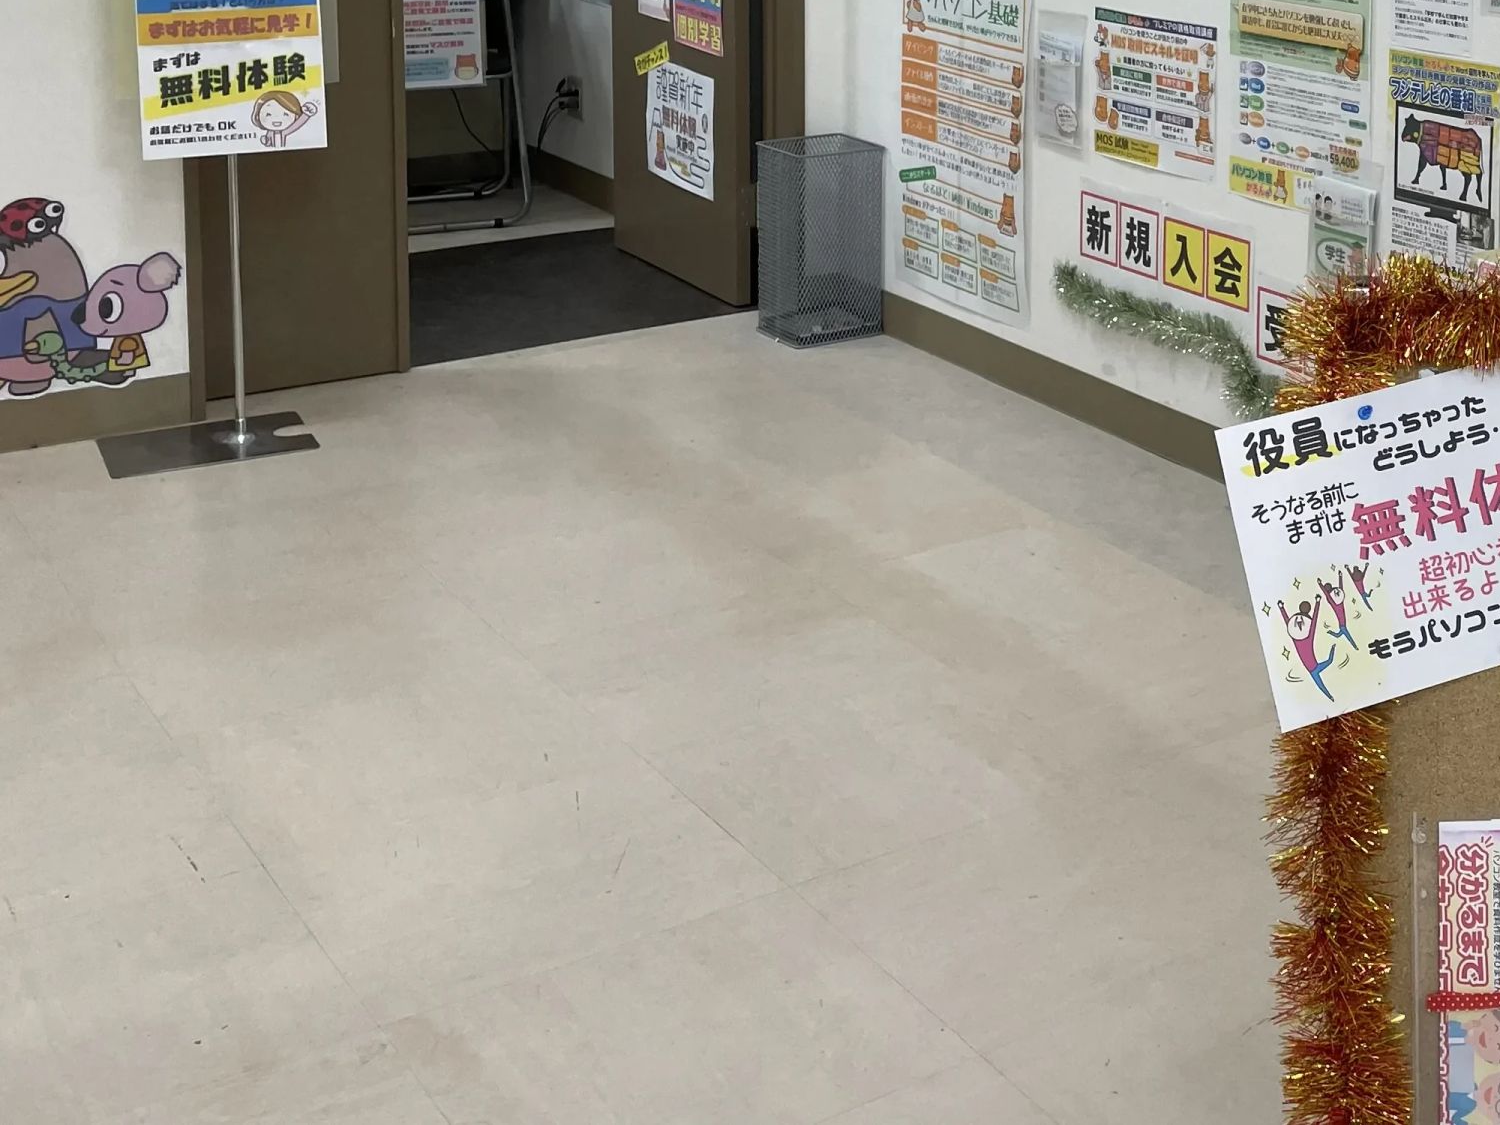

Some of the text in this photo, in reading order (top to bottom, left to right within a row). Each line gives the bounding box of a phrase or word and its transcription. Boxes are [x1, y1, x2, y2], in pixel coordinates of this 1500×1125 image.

[152, 52, 201, 72] まずは
[159, 52, 306, 108] 無料体験
[1252, 480, 1360, 524] そうなる前に
[1285, 507, 1347, 545] まずは
